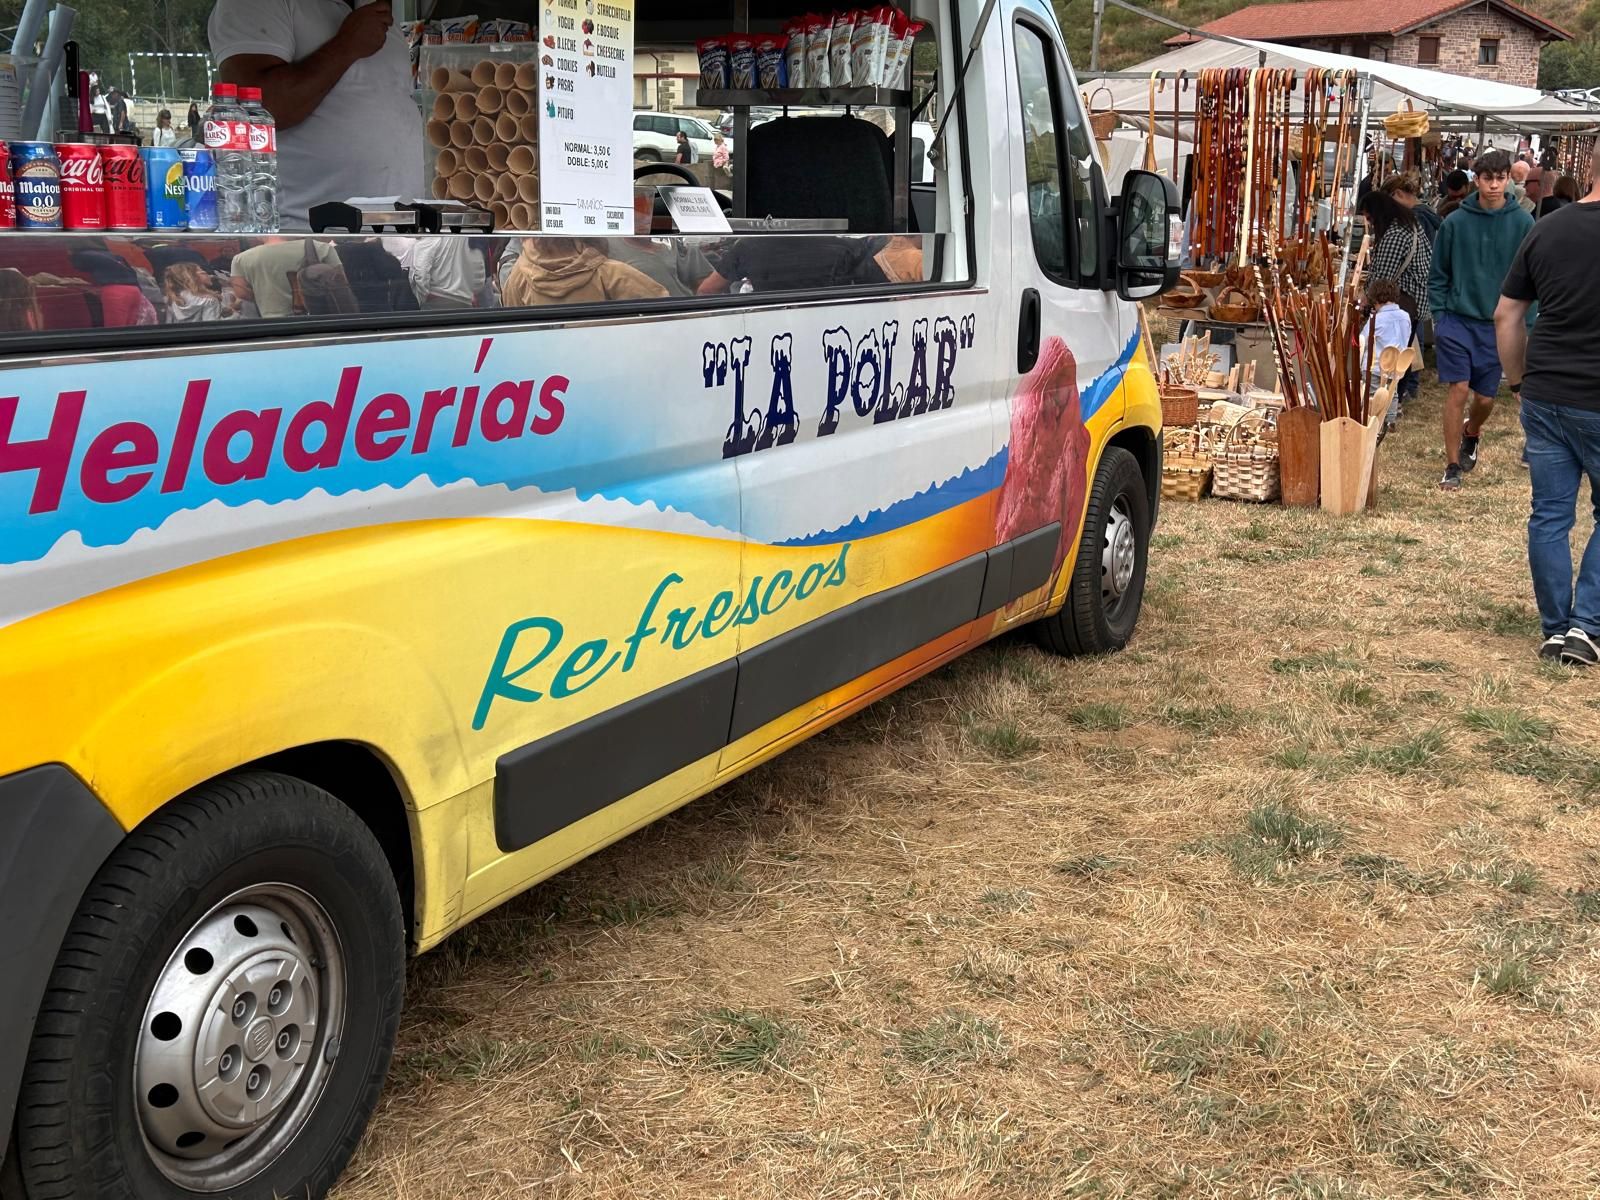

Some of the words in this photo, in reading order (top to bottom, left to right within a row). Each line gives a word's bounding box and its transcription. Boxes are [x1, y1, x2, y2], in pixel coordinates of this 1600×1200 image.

[597, 3, 631, 21] STRACCIATELLA
[557, 16, 575, 30] YOGUR
[597, 24, 619, 40] F.BOSQUE
[557, 37, 577, 52] D.LECHE
[597, 44, 625, 61] CHEESECAKE
[557, 58, 578, 72] COOKIES
[596, 64, 616, 78] NUTELLA
[557, 78, 574, 92] PASAS
[557, 106, 574, 120] PITUFO
[564, 142, 593, 154] NORMAL:
[594, 145, 606, 156] 3,50
[567, 156, 591, 167] DOBLE:
[591, 158, 604, 170] 5,00
[19, 181, 61, 194] Mahou
[32, 195, 54, 210] 0,0
[0, 338, 570, 514] Heladerías
[471, 542, 851, 731] Refrescos
